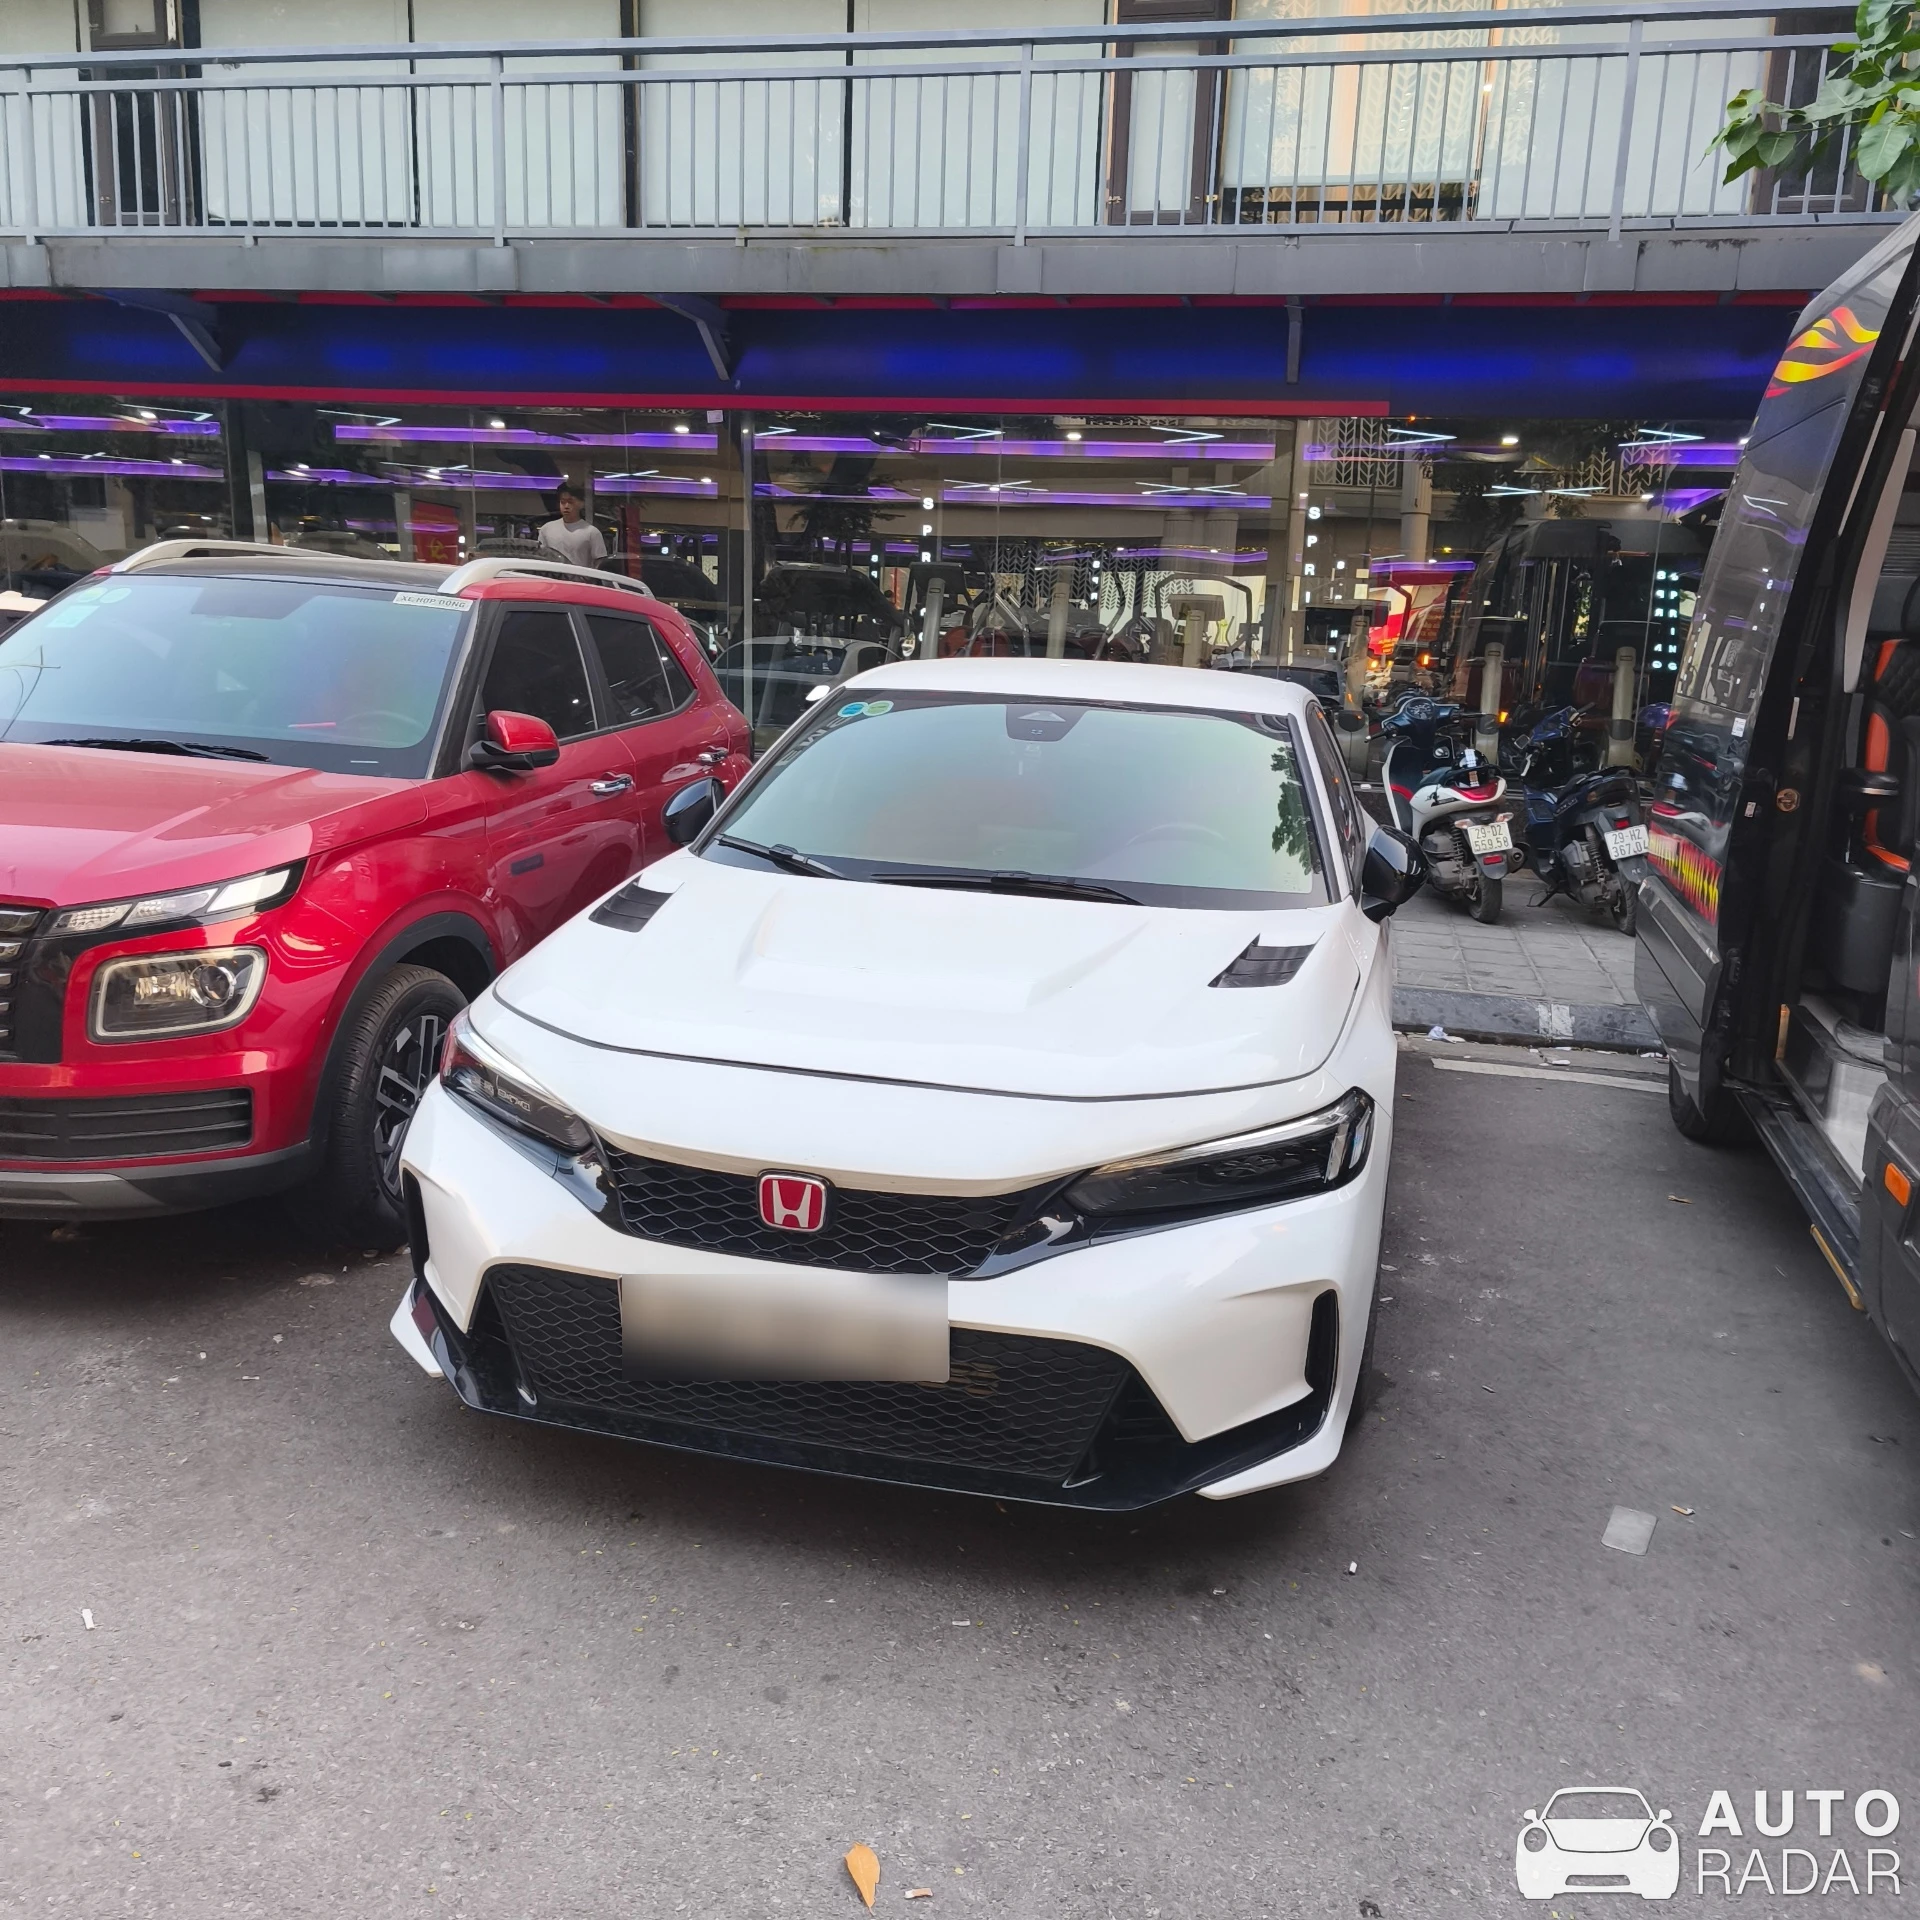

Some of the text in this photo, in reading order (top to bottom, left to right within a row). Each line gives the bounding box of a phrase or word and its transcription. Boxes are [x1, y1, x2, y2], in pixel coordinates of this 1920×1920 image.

[1474, 824, 1503, 840] 29-D2
[1612, 828, 1643, 845] 29-H2
[1474, 836, 1510, 852] 559.58
